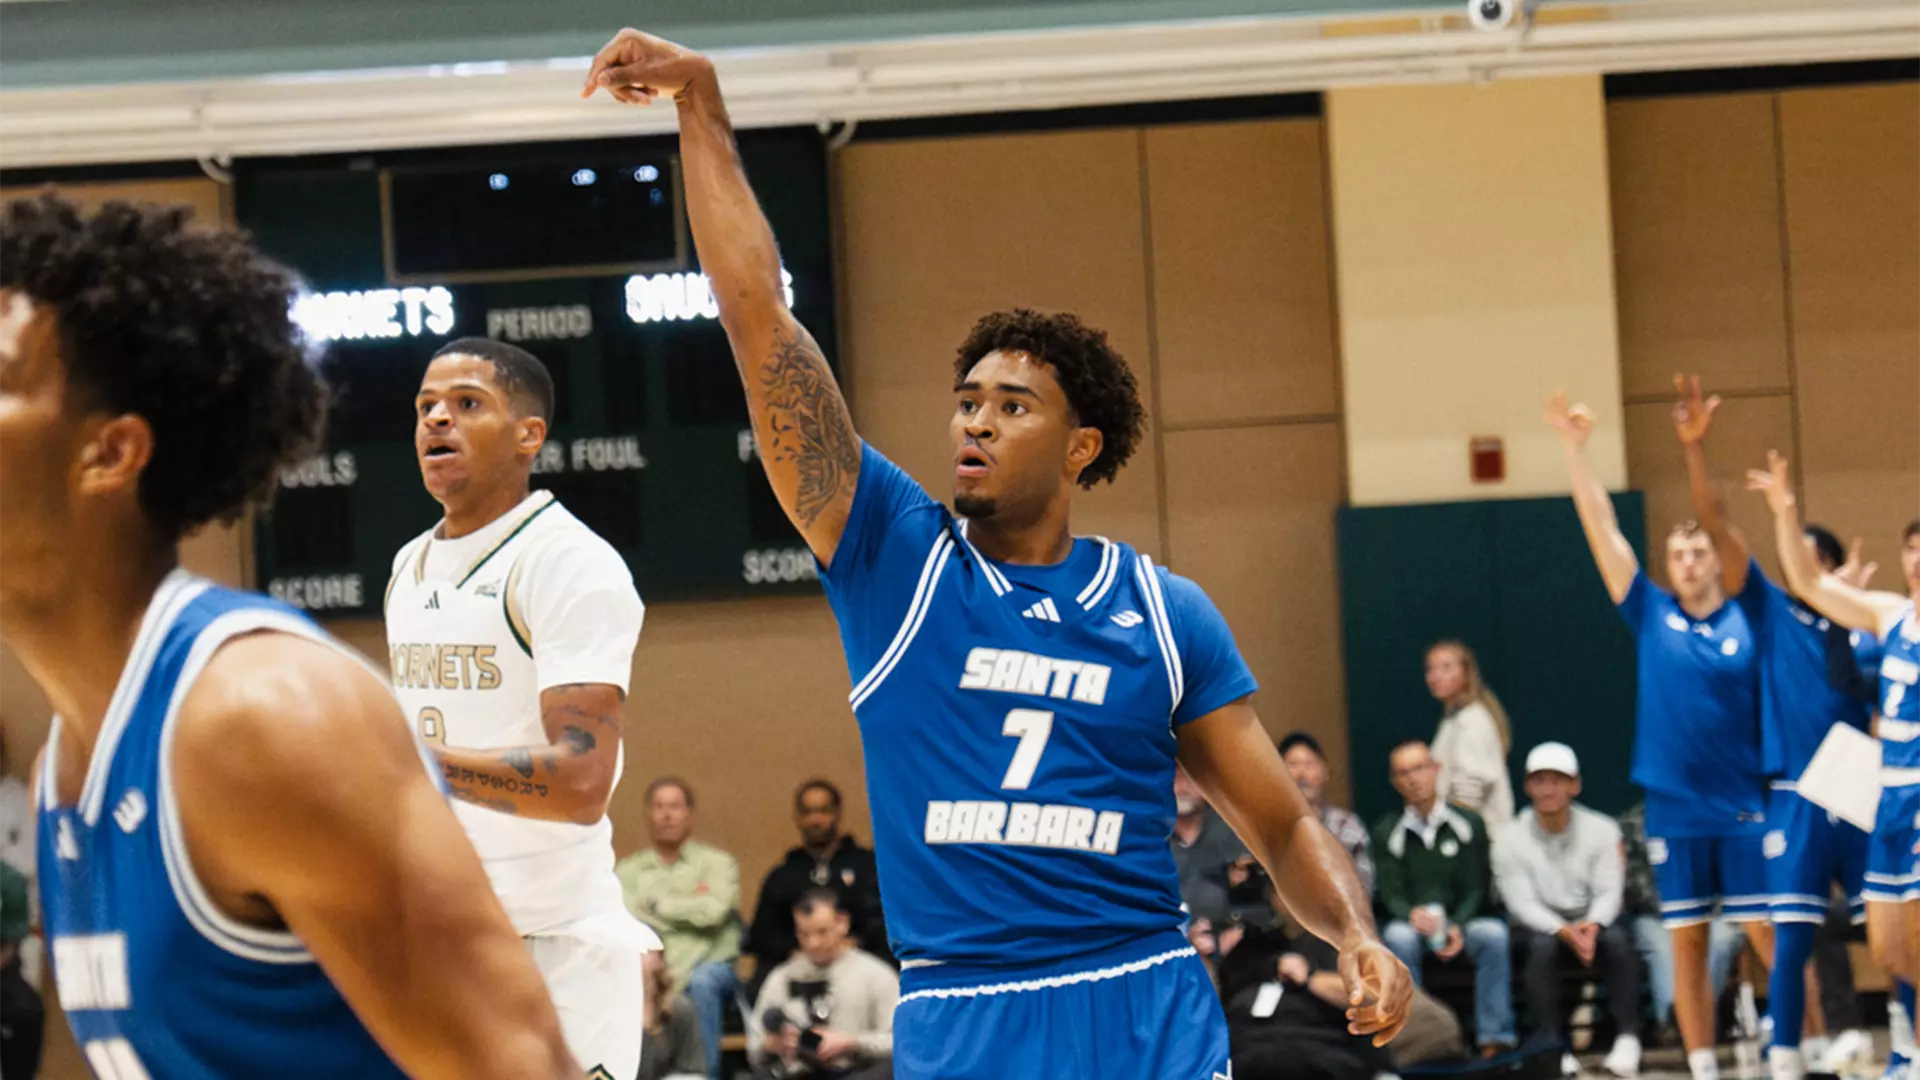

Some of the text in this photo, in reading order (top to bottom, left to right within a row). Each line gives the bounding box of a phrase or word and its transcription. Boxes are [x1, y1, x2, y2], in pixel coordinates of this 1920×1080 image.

[486, 305, 593, 340] PERIOD
[279, 449, 359, 488] OULS
[571, 436, 648, 472] FOUL
[742, 547, 818, 585] SCOR
[391, 642, 503, 690] ORNETS
[959, 647, 1112, 705] SANTA
[1000, 708, 1055, 790] 7
[924, 800, 1125, 856] BARBARA
